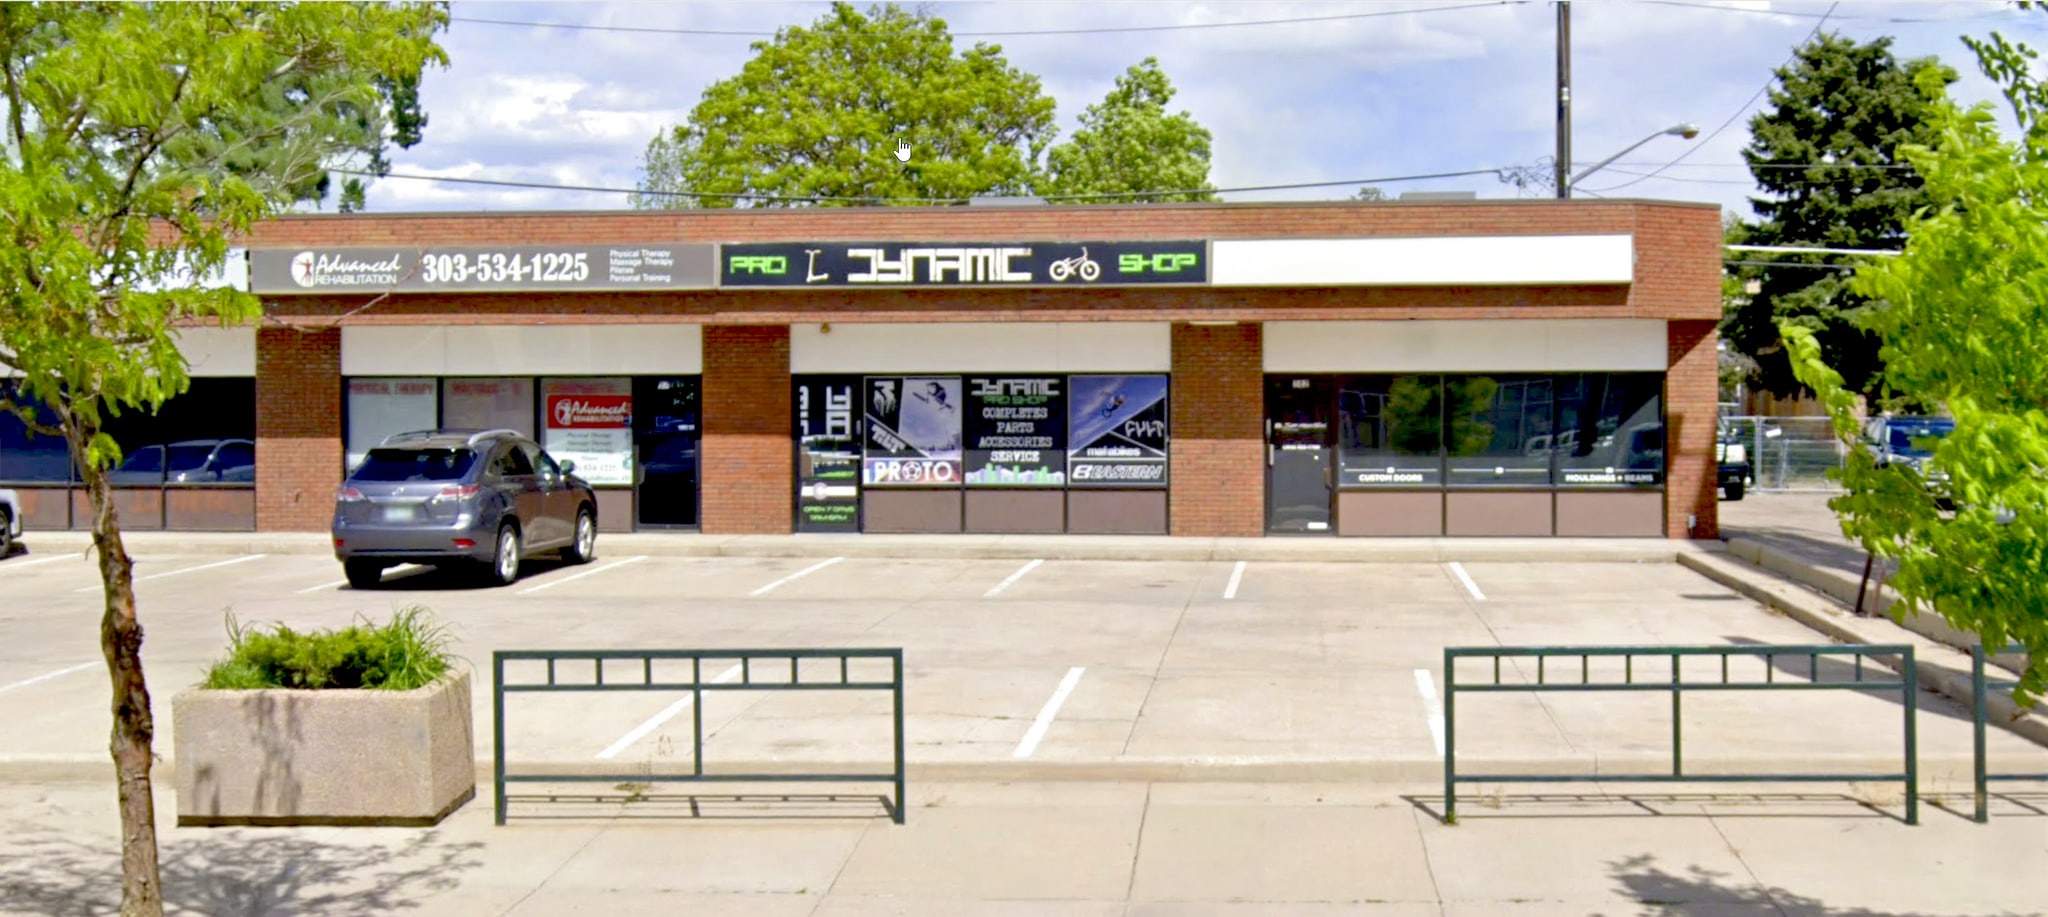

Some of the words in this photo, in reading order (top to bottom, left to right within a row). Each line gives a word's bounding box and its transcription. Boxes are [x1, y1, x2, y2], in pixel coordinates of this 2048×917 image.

[609, 249, 639, 257] Physical
[641, 249, 671, 259] Therapy
[316, 254, 401, 273] Advanced
[422, 253, 589, 282] 303-534-1225
[609, 258, 642, 266] Massage
[643, 258, 673, 267] Therapy
[730, 256, 786, 274] PRO
[847, 248, 1032, 282] DYNAMIC
[1118, 253, 1197, 272] SHOP
[315, 274, 397, 284] REHABILITATION
[609, 273, 641, 281] Personal
[643, 273, 671, 283] Training
[971, 379, 1060, 395] DYNAMIC
[571, 401, 627, 414] Advanced
[983, 407, 1048, 419] COMPLETES
[997, 422, 1034, 433] PARTS
[979, 437, 1052, 448] ACCESSORIES
[991, 452, 1040, 462] SERVICE
[874, 461, 953, 482] PROTO
[1091, 465, 1163, 479] EASTERN
[1358, 474, 1392, 482] CUSTOM
[1393, 474, 1423, 482] DOORS
[1565, 474, 1616, 482] MOULDINGS
[1624, 474, 1654, 482] BEAMS
